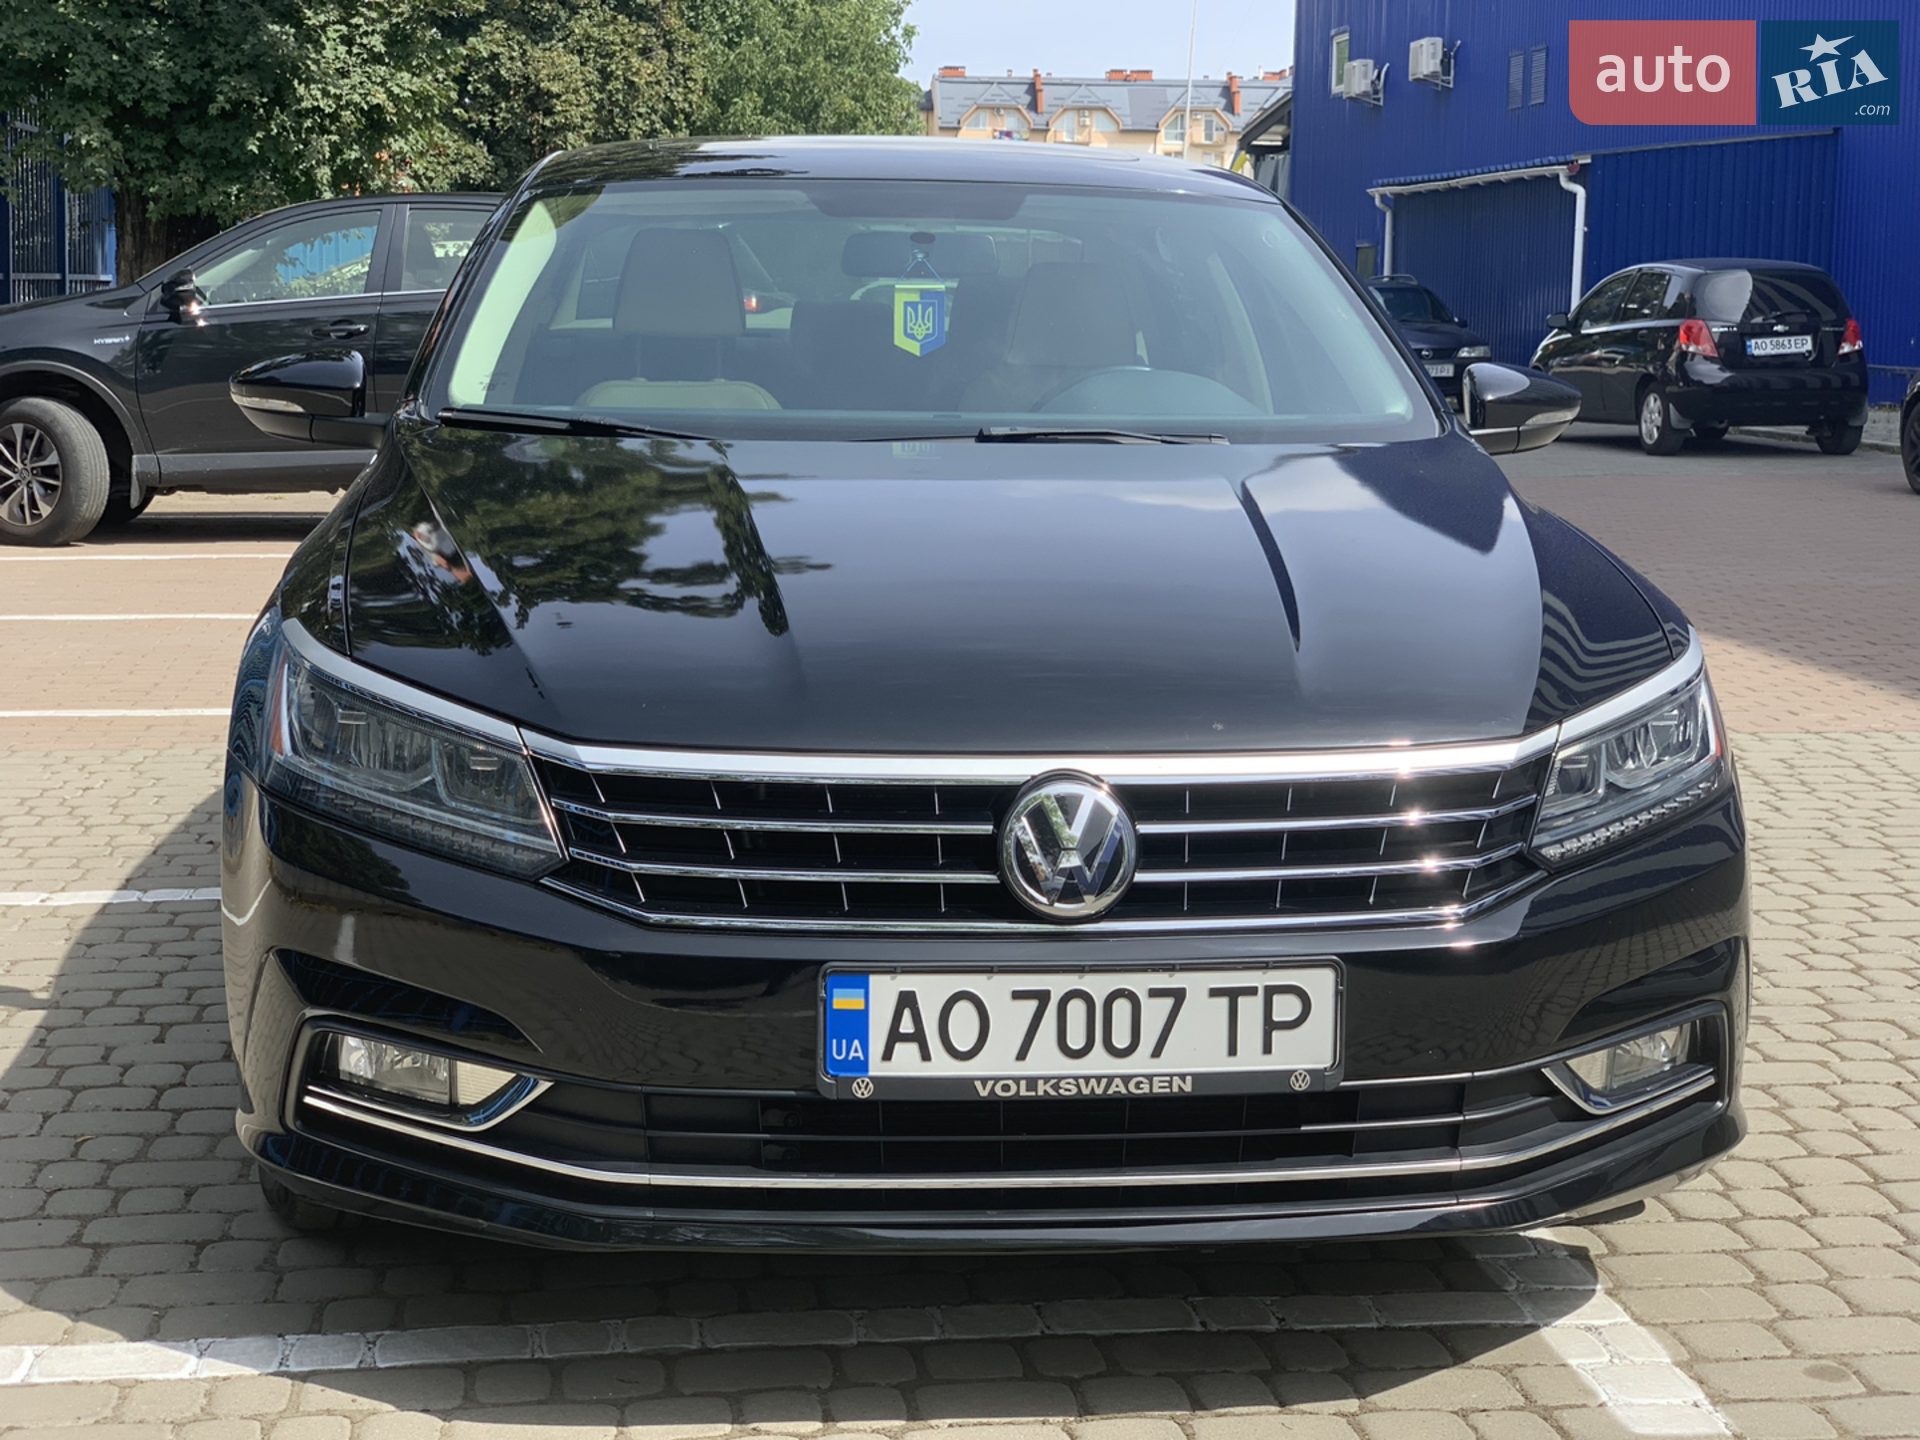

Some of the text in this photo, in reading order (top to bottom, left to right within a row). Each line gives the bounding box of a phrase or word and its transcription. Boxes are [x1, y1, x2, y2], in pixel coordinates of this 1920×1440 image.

[1754, 340, 1768, 351] AO
[1769, 338, 1793, 351] 5863
[1794, 338, 1809, 349] EP
[880, 983, 1313, 1062] AO 7007 TP
[832, 1038, 865, 1061] UA
[973, 1075, 1193, 1097] VOLKSWAGEN
